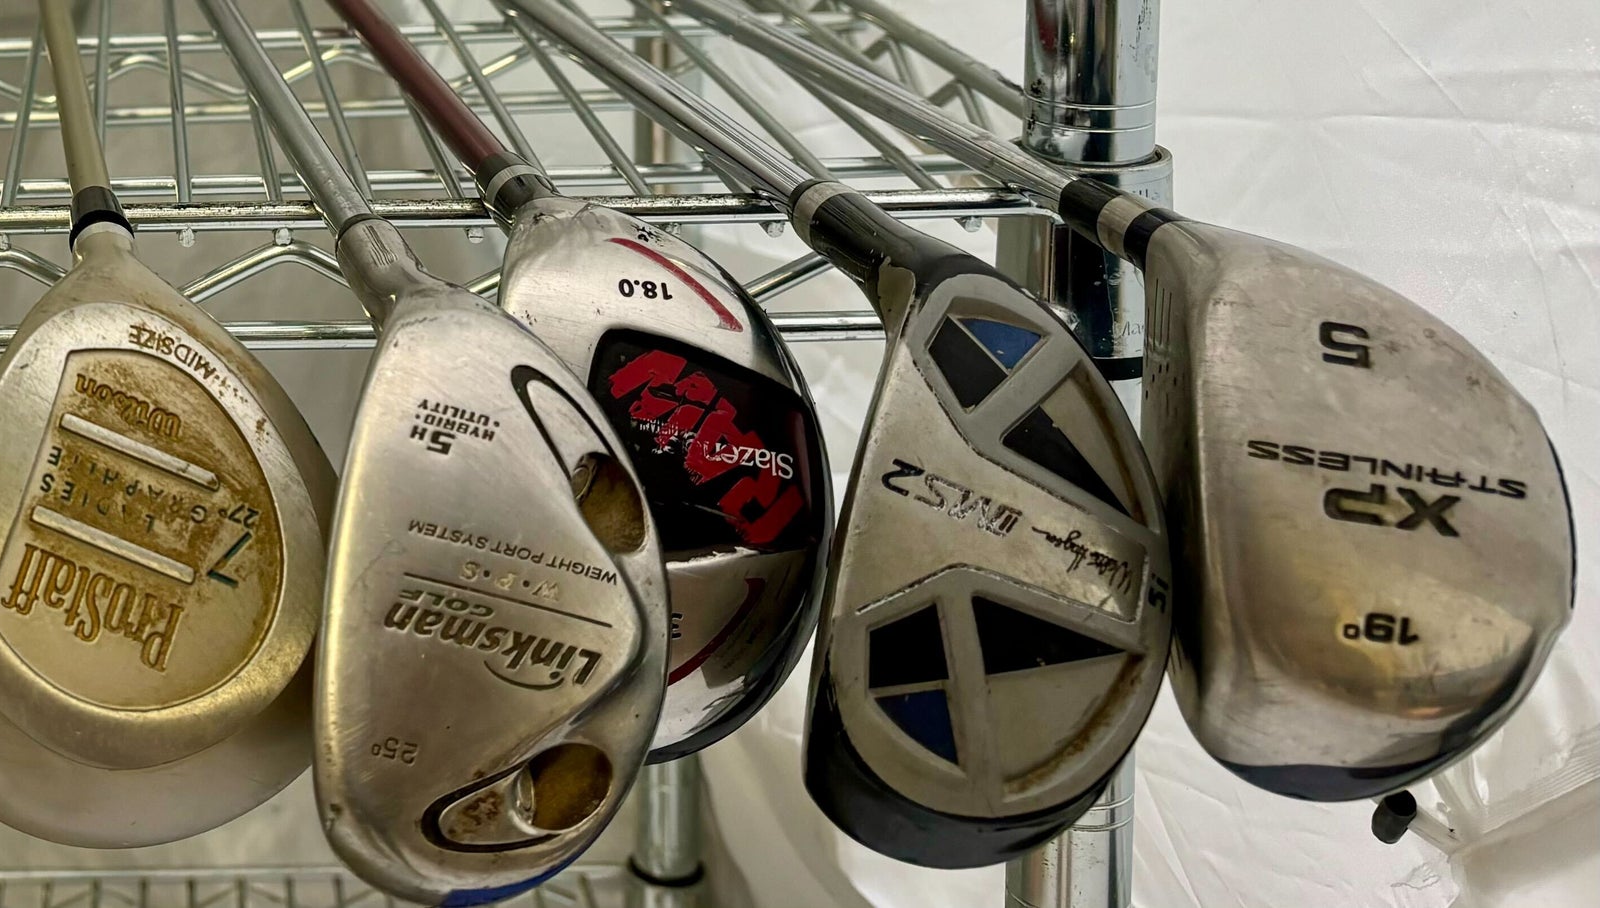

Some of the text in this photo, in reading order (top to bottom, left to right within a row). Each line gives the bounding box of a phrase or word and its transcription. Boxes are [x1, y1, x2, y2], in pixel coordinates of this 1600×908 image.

[618, 278, 672, 301] 18.0
[129, 324, 217, 379] MIDSIZE
[1319, 320, 1370, 369] 5
[75, 374, 181, 439] Wilson
[417, 399, 490, 427] UTILITY
[423, 413, 497, 442] HYBRID
[409, 425, 457, 456] 5H
[1247, 440, 1527, 499] STAINLESS
[1323, 484, 1461, 538] XP
[207, 529, 253, 589] 7
[408, 518, 619, 586] WEIGHT PORT SYSTEM
[398, 588, 495, 618] GOLF
[383, 601, 603, 688] Linksman
